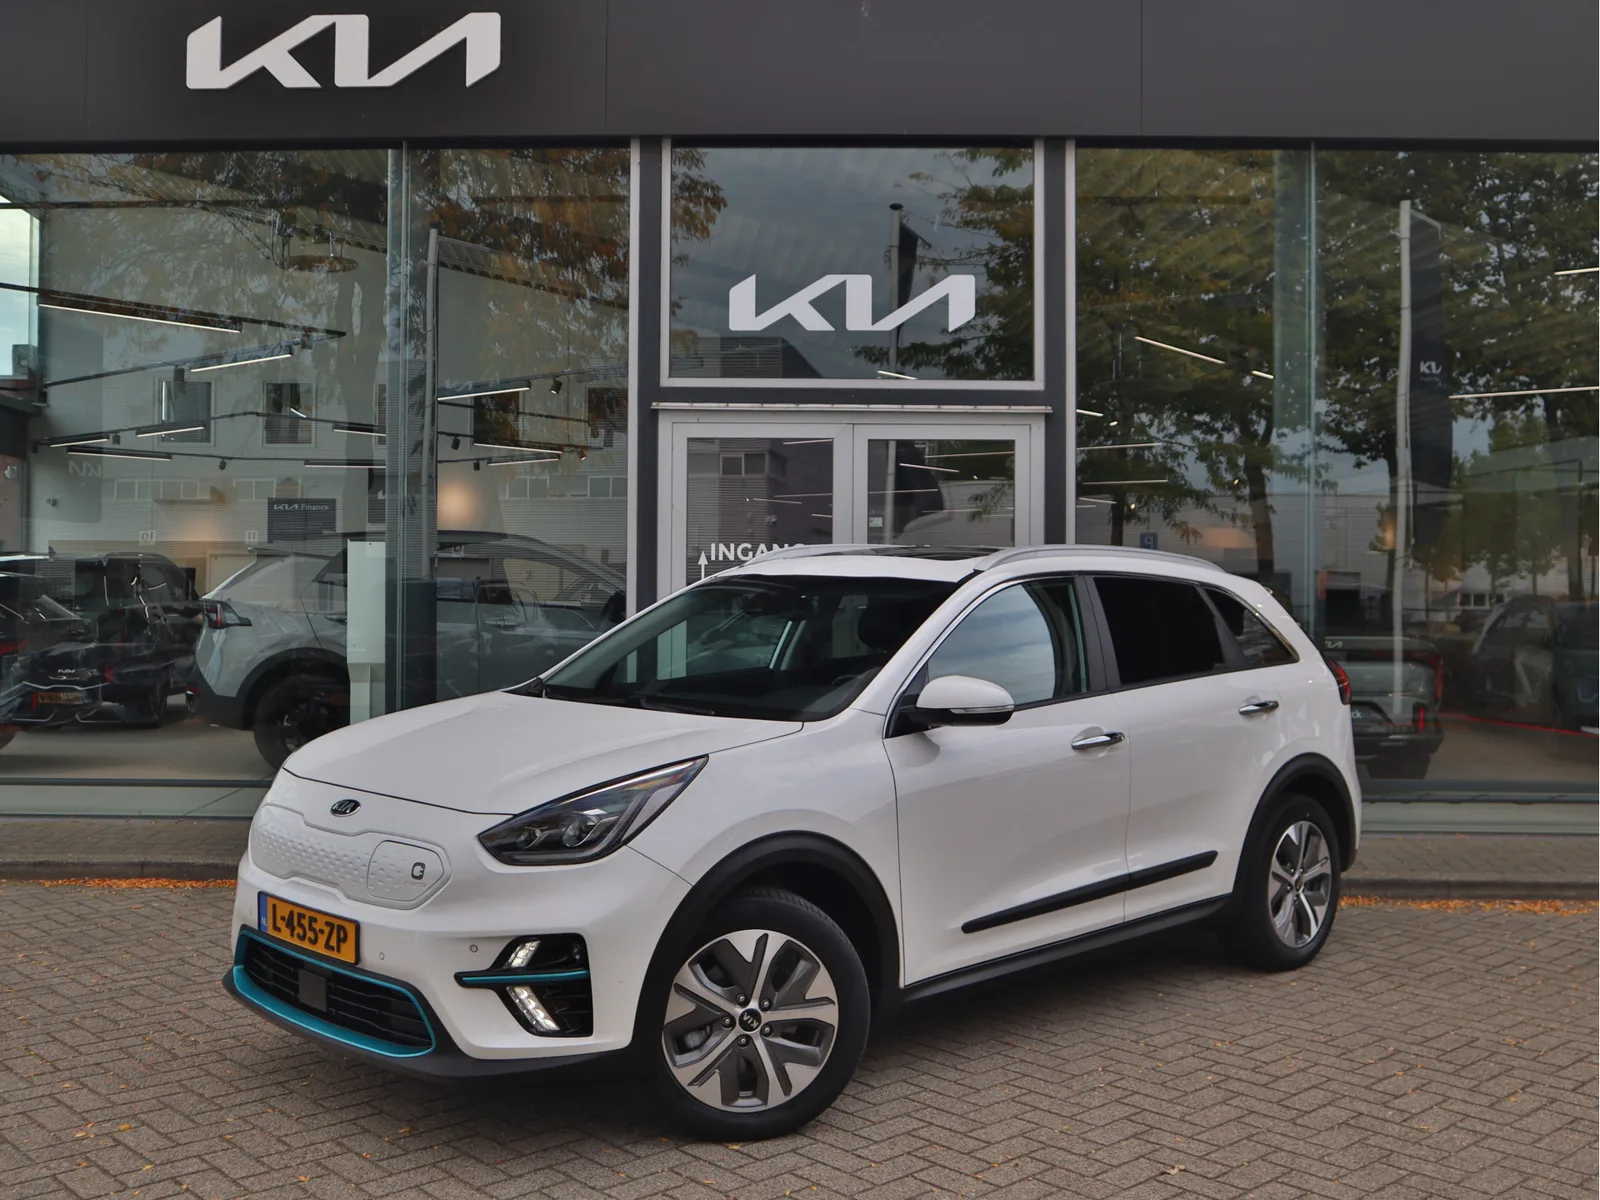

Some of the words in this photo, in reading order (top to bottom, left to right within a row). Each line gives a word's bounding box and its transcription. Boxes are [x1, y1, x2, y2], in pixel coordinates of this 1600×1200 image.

[186, 12, 502, 90] KIA
[729, 273, 976, 333] KIA
[273, 503, 299, 511] KIA
[300, 503, 330, 511] Finance
[710, 542, 805, 561] INGA
[271, 903, 348, 953] L-455-ZP
[743, 1012, 759, 1029] KIA
